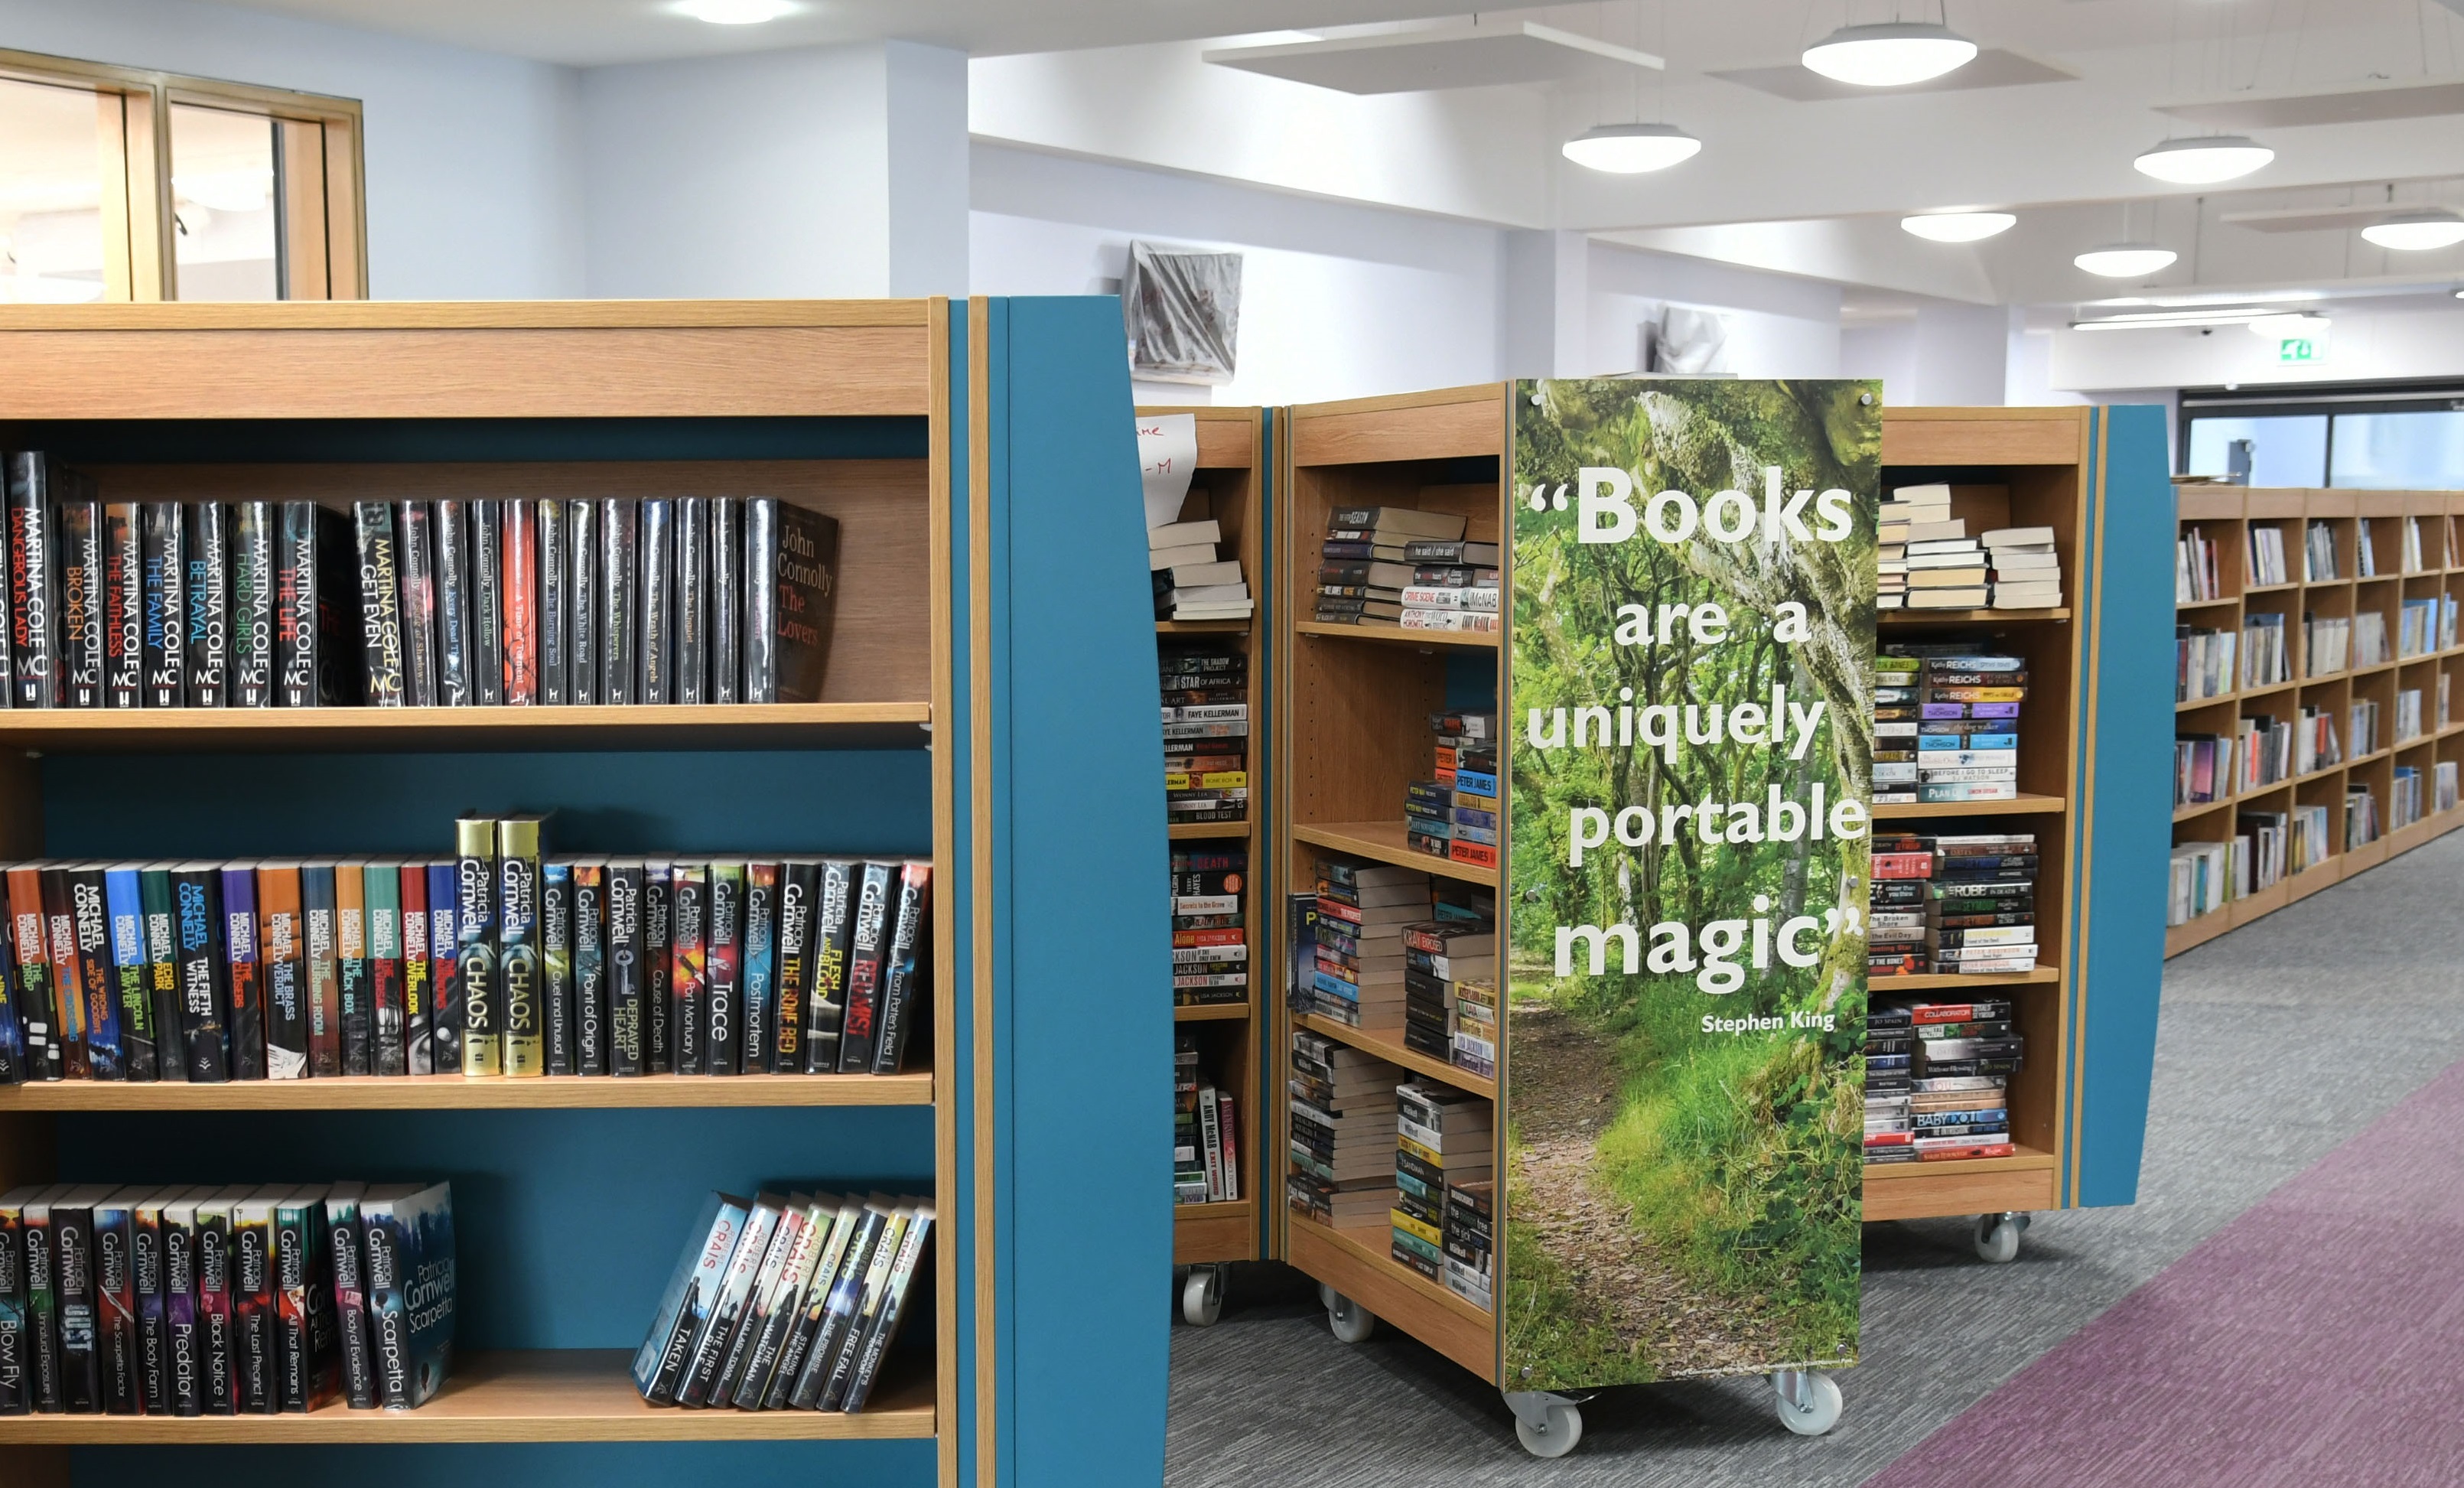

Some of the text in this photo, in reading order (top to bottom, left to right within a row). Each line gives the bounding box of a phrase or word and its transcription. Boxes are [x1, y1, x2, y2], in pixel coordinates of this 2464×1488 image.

[480, 547, 492, 592] Connolly
[782, 525, 815, 558] John
[11, 507, 28, 648] DANGEROUS LADY
[24, 507, 45, 648] MARTINA COLE
[83, 538, 99, 668] MARTINA COLE
[147, 556, 163, 650] THE FAMILY
[164, 538, 180, 668] MARTINA COLE
[190, 560, 207, 644] BETRAYAL
[483, 591, 491, 614] Dark
[777, 552, 833, 597] Connolly
[779, 584, 806, 612] The
[1472, 593, 1498, 608] McNAB
[67, 566, 83, 641] BROKEN
[109, 555, 122, 658] THE FAITHLESS
[123, 540, 139, 669] MARTINA COLE
[207, 539, 223, 668] MARTINA COLE
[236, 553, 252, 654] HARD GIRLS
[253, 539, 269, 668] MARTINA COLE
[279, 566, 297, 642] THE LIFE
[296, 539, 311, 668] MARTINA COLE
[361, 565, 382, 648] GET EVEN
[375, 539, 399, 669] MARTINA COLE
[548, 591, 558, 667] The Burning Soul
[578, 612, 588, 639] White
[777, 612, 819, 646] Lovers
[1614, 599, 1812, 646] are a
[483, 619, 491, 647] Hollow
[579, 641, 588, 663] Road
[516, 644, 525, 684] Torment
[1180, 676, 1200, 689] STAR
[1949, 675, 1981, 684] REICHS
[1203, 708, 1239, 718] KELLERMAN
[1528, 684, 1826, 764] uniquely
[1457, 775, 1492, 791] PETER JAMES
[1196, 812, 1216, 820] BLOOD
[1570, 782, 1867, 868] portable
[461, 859, 482, 935] Cornwell
[477, 871, 491, 923] Patricia
[503, 860, 525, 936] Cornwell
[519, 872, 534, 924] Patricia
[611, 877, 630, 945] Cornwell
[625, 888, 637, 934] Patricia
[835, 881, 849, 925] Patricia
[1193, 874, 1201, 896] HAYES
[74, 883, 94, 952] CONNELLY
[86, 886, 105, 949] MICHAEL
[148, 914, 164, 965] CONNELLY
[158, 913, 171, 957] MICHAEL
[179, 882, 195, 952] CONNELLY
[191, 885, 208, 948] MICHAEL
[272, 913, 284, 963] CONNELLY
[281, 913, 292, 956] MICHAEL
[782, 884, 802, 954] Cornwell
[794, 906, 807, 947] Patricia
[1174, 933, 1195, 945] Alone
[22, 963, 34, 991] DROP
[32, 962, 43, 983] THE
[119, 964, 132, 1008] LAWYER
[154, 963, 165, 991] PARK
[163, 962, 174, 991] ECHO
[187, 960, 200, 1014] WITNESS
[197, 956, 212, 1016] THE FIFTH
[274, 962, 285, 1006] VERDICT
[282, 962, 295, 1021] THE BRASS
[406, 961, 418, 1015] OVERLOOK
[415, 960, 426, 982] THE
[466, 956, 489, 1030] CHAOS
[509, 958, 531, 1031] CHAOS
[816, 937, 832, 999] AND BLOOD
[829, 949, 843, 991] FLESH
[1174, 963, 1208, 975] JACKSON
[129, 964, 145, 1031] THE LINCOLN
[582, 973, 597, 1059] Point of Origin
[653, 969, 664, 1053] Cause of Death
[682, 982, 696, 1055] Port Mortuary
[712, 981, 733, 1042] Trace
[749, 972, 765, 1058] Postmortem
[779, 957, 801, 1054] THE BONE BED
[1701, 1011, 1835, 1037] Stephen King
[614, 1007, 627, 1053] HEART
[626, 998, 640, 1061] DEPRAVED
[1917, 1115, 1948, 1127] BABY
[369, 1228, 391, 1289] Cornwell
[418, 1256, 451, 1286] Patricia
[703, 1219, 731, 1270] CRAIS
[403, 1258, 455, 1311] Cornwell
[409, 1297, 453, 1334] Scarpetta
[0, 1320, 20, 1389] Blow Fly
[145, 1316, 159, 1398] The Body Farm
[175, 1324, 194, 1398] Predator
[211, 1313, 226, 1396] Black Notice
[250, 1314, 262, 1395] The Last Precinct
[347, 1309, 363, 1392] Body of Evidence
[382, 1311, 404, 1393] Scarpetta
[665, 1328, 692, 1372] TAKEN
[699, 1326, 729, 1383] THE FIRST
[832, 1327, 861, 1382] FREE FALL
